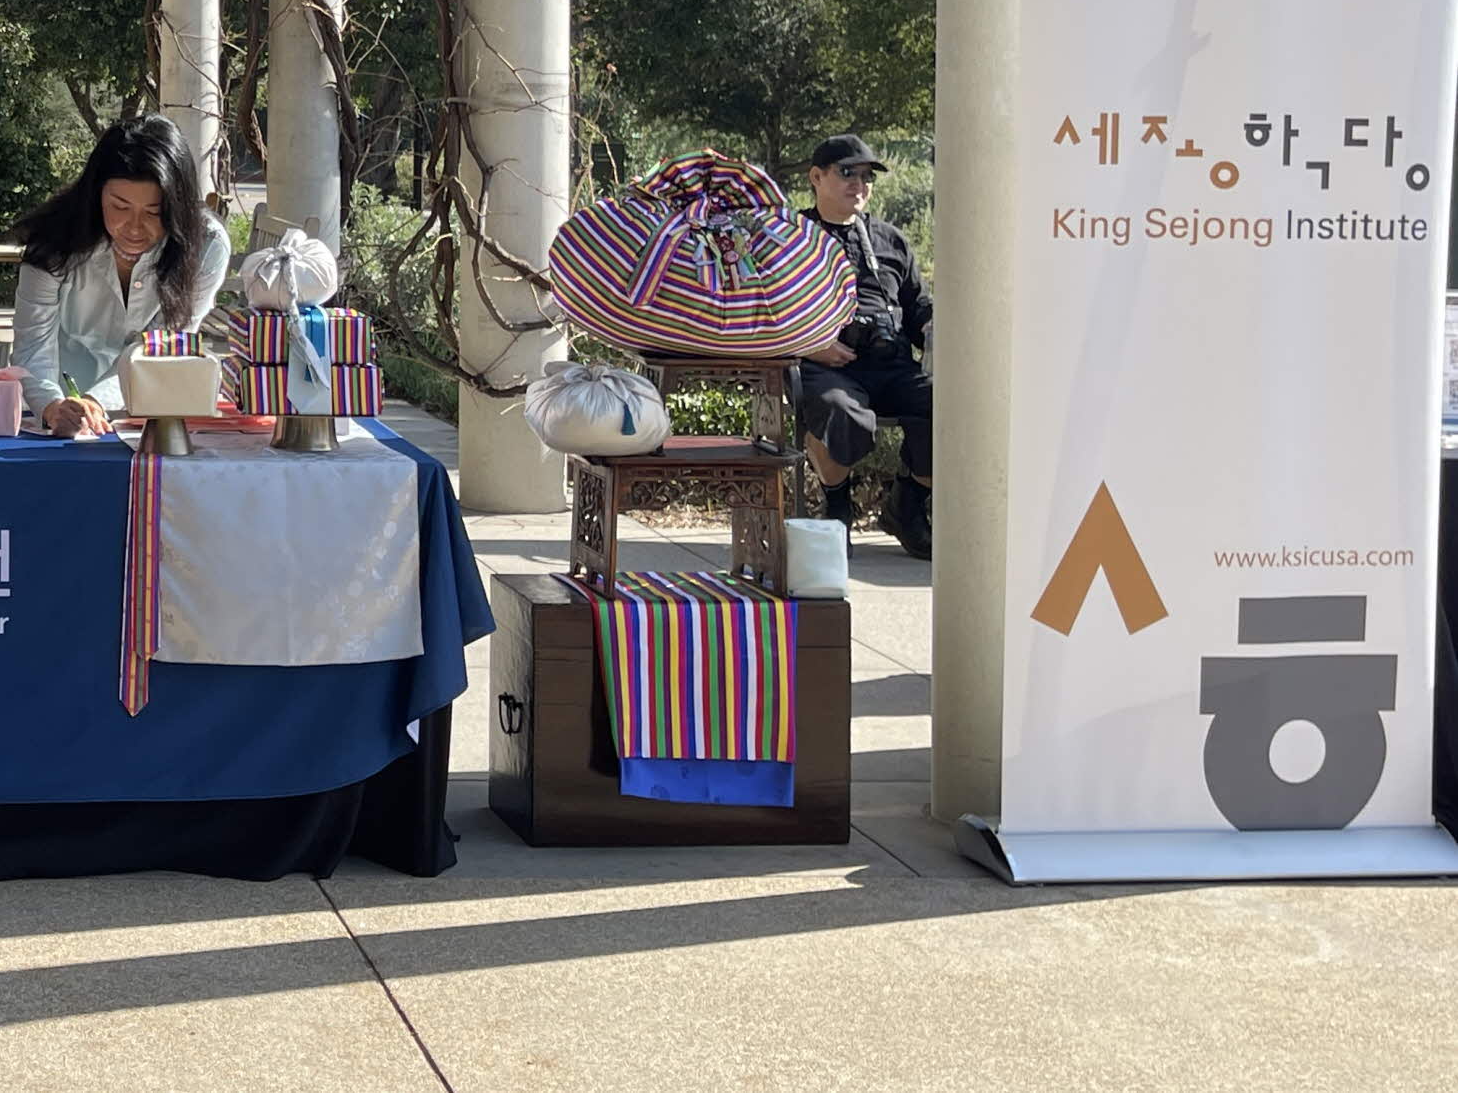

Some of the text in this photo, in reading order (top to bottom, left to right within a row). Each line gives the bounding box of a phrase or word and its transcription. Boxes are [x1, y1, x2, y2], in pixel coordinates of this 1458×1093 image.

[1053, 113, 1430, 191] 세종학당
[1053, 208, 1428, 247] King Sejong Institute
[1214, 546, 1414, 568] www.ksicusa.com
